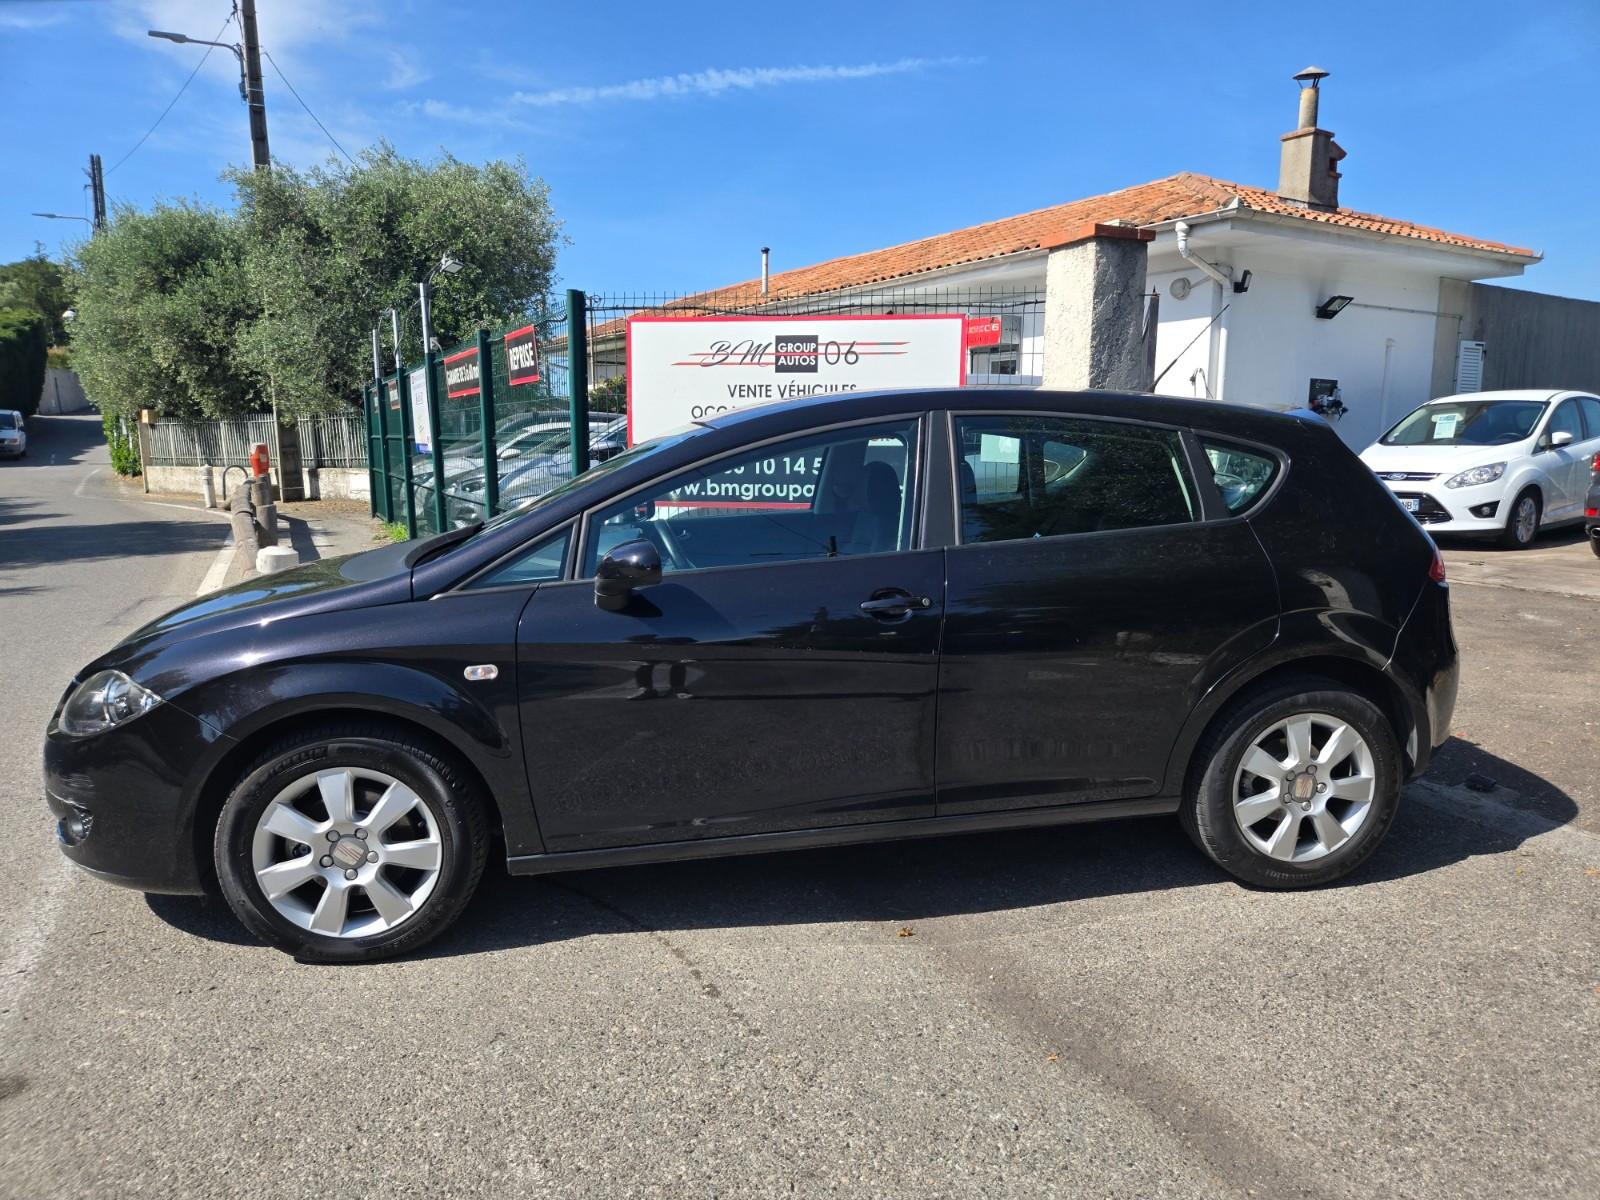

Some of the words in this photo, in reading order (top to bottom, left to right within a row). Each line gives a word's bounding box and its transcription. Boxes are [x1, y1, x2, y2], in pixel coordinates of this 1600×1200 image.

[509, 341, 535, 370] REPRISE
[700, 340, 773, 367] BM
[777, 342, 817, 353] GROUP
[824, 340, 859, 365] 06
[777, 355, 816, 366] AUTOS
[727, 384, 772, 398] VENTE
[755, 458, 776, 475] 10
[782, 456, 806, 475] 14
